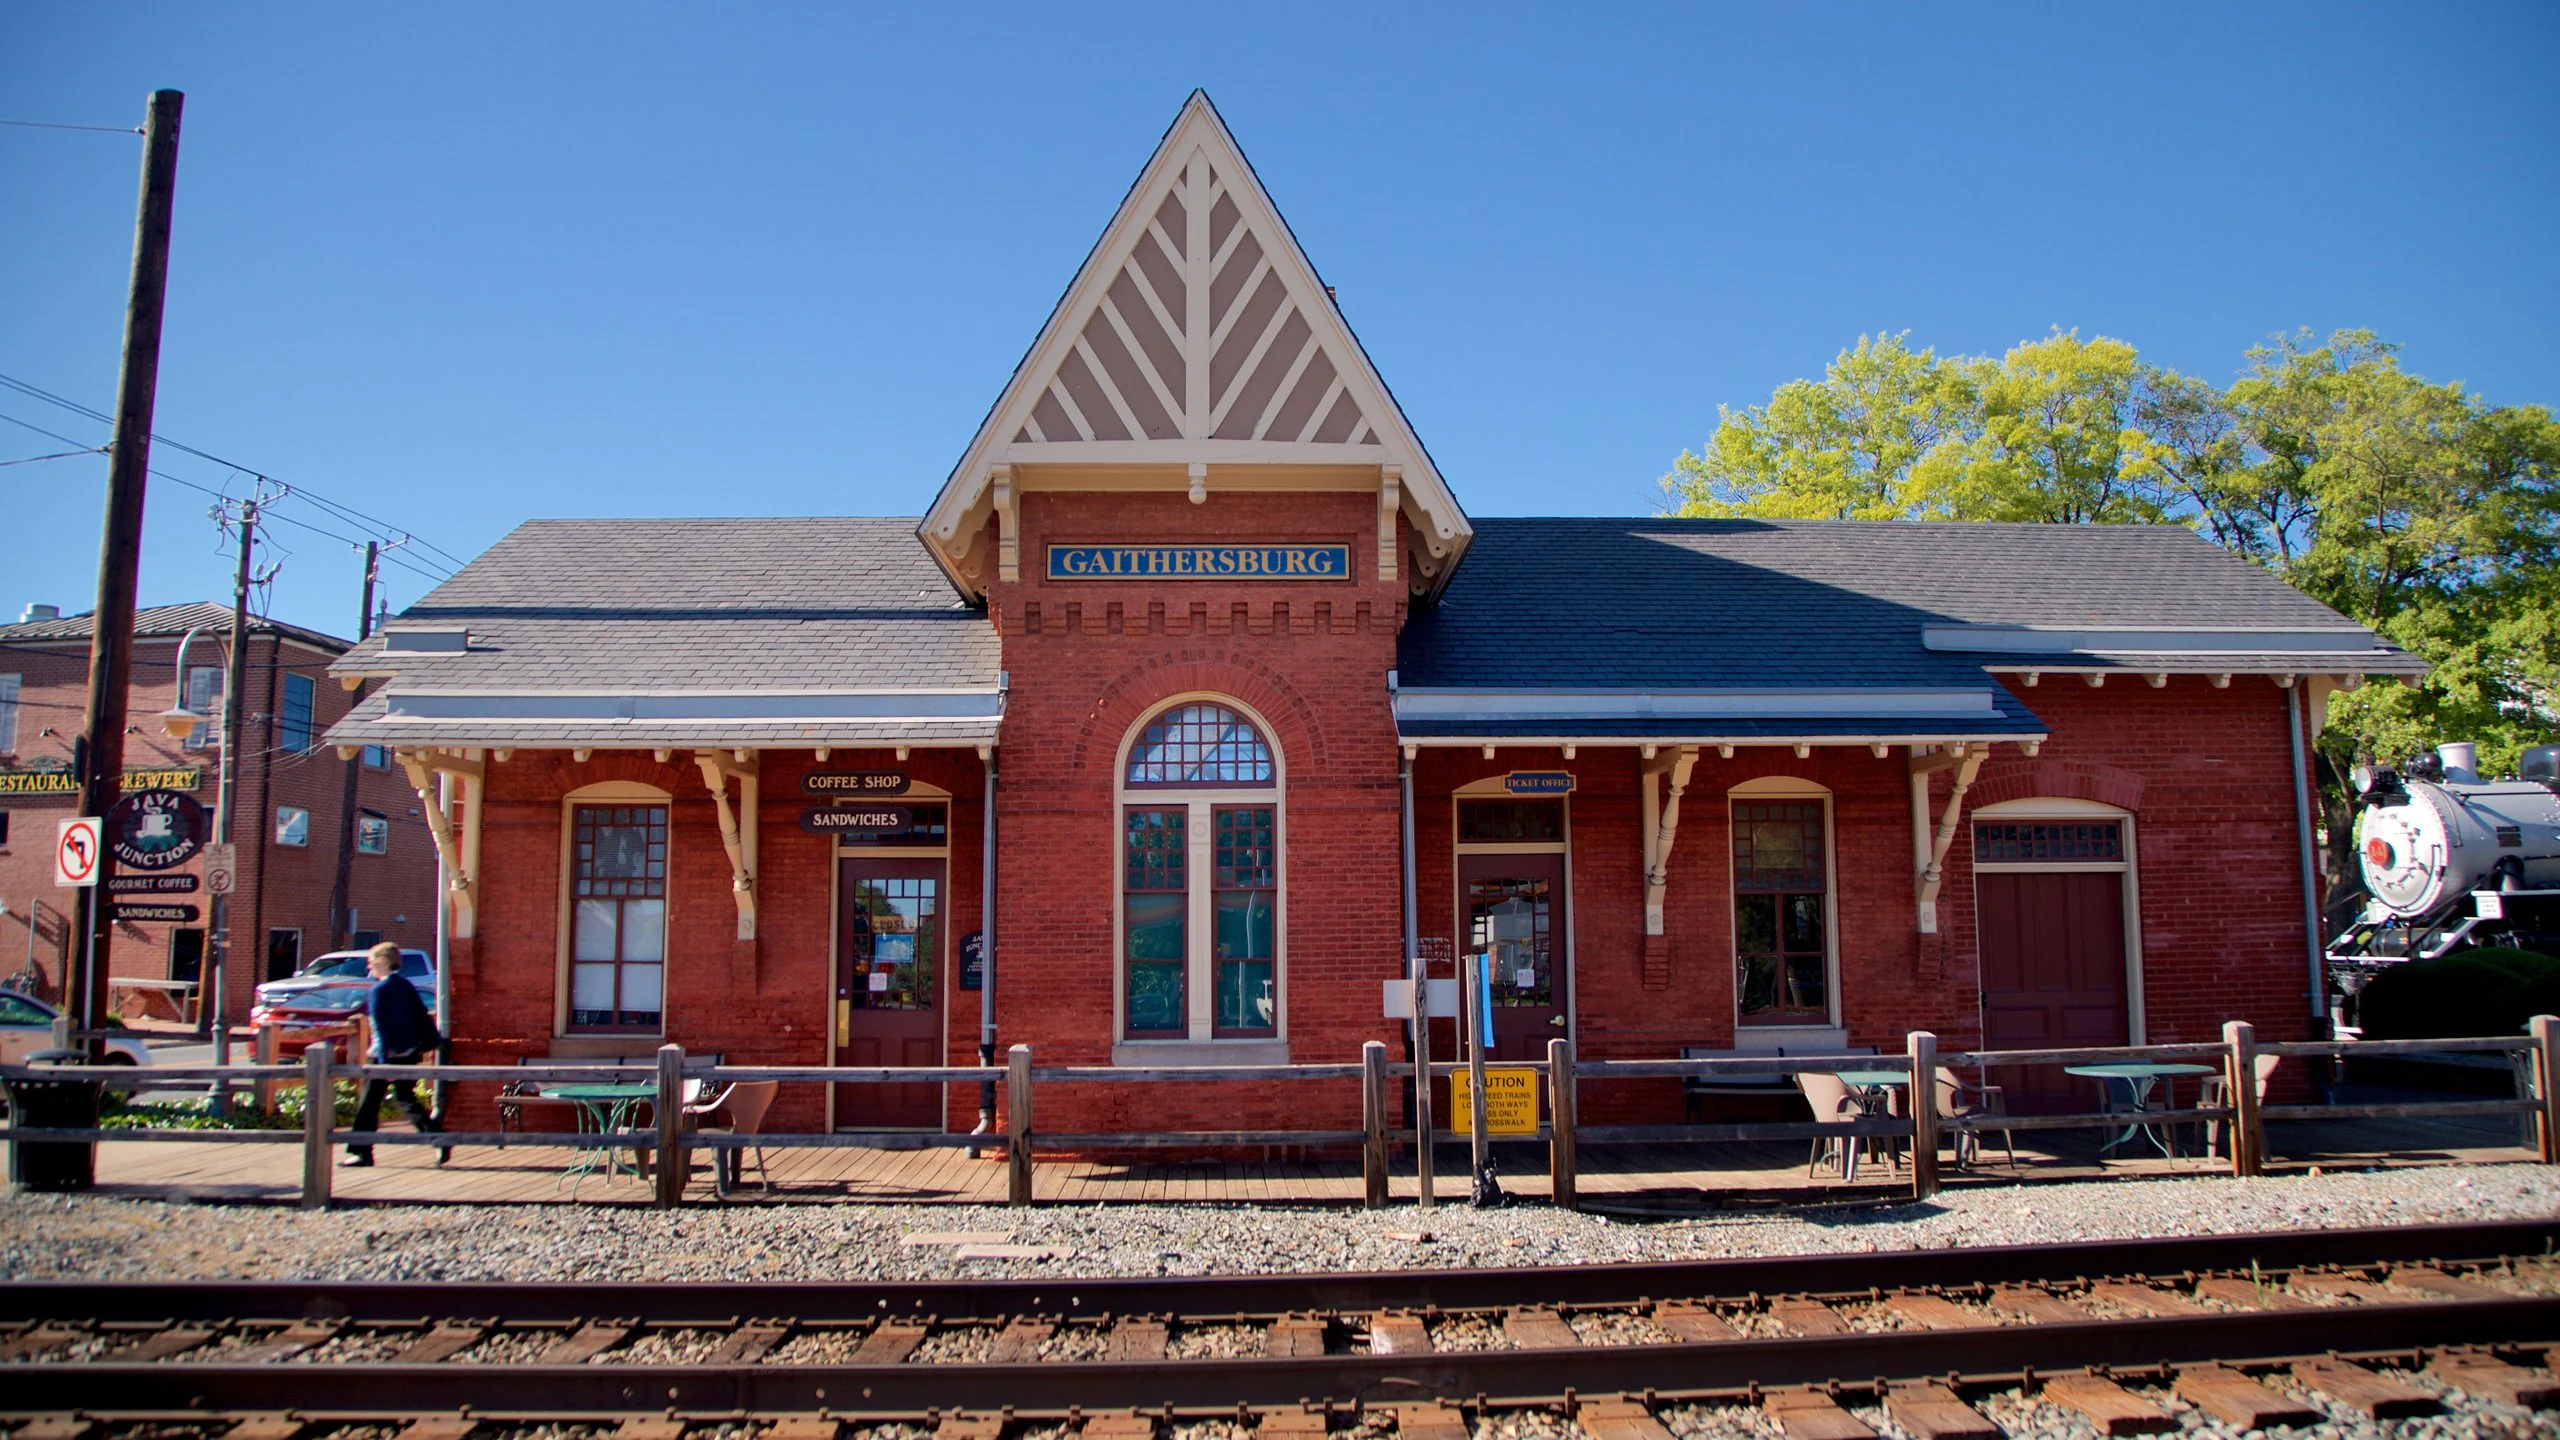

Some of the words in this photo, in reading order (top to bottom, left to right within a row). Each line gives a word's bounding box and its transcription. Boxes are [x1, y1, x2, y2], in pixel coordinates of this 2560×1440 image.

[1062, 550, 1333, 573] GAITHERSBURG
[120, 771, 196, 789] REWERY
[808, 776, 859, 788] COFFEE
[864, 775, 901, 788] SHOP
[1507, 778, 1538, 787] TICKET
[1541, 778, 1573, 787] OFFICE
[132, 794, 180, 810] JAVA
[813, 813, 899, 826] SANDWICHES
[113, 838, 195, 866] JUNCTION
[108, 878, 154, 890] GOURMET
[157, 877, 193, 888] COFFEE
[117, 907, 186, 918] SANDWICHES
[1465, 1077, 1524, 1087] CUTION
